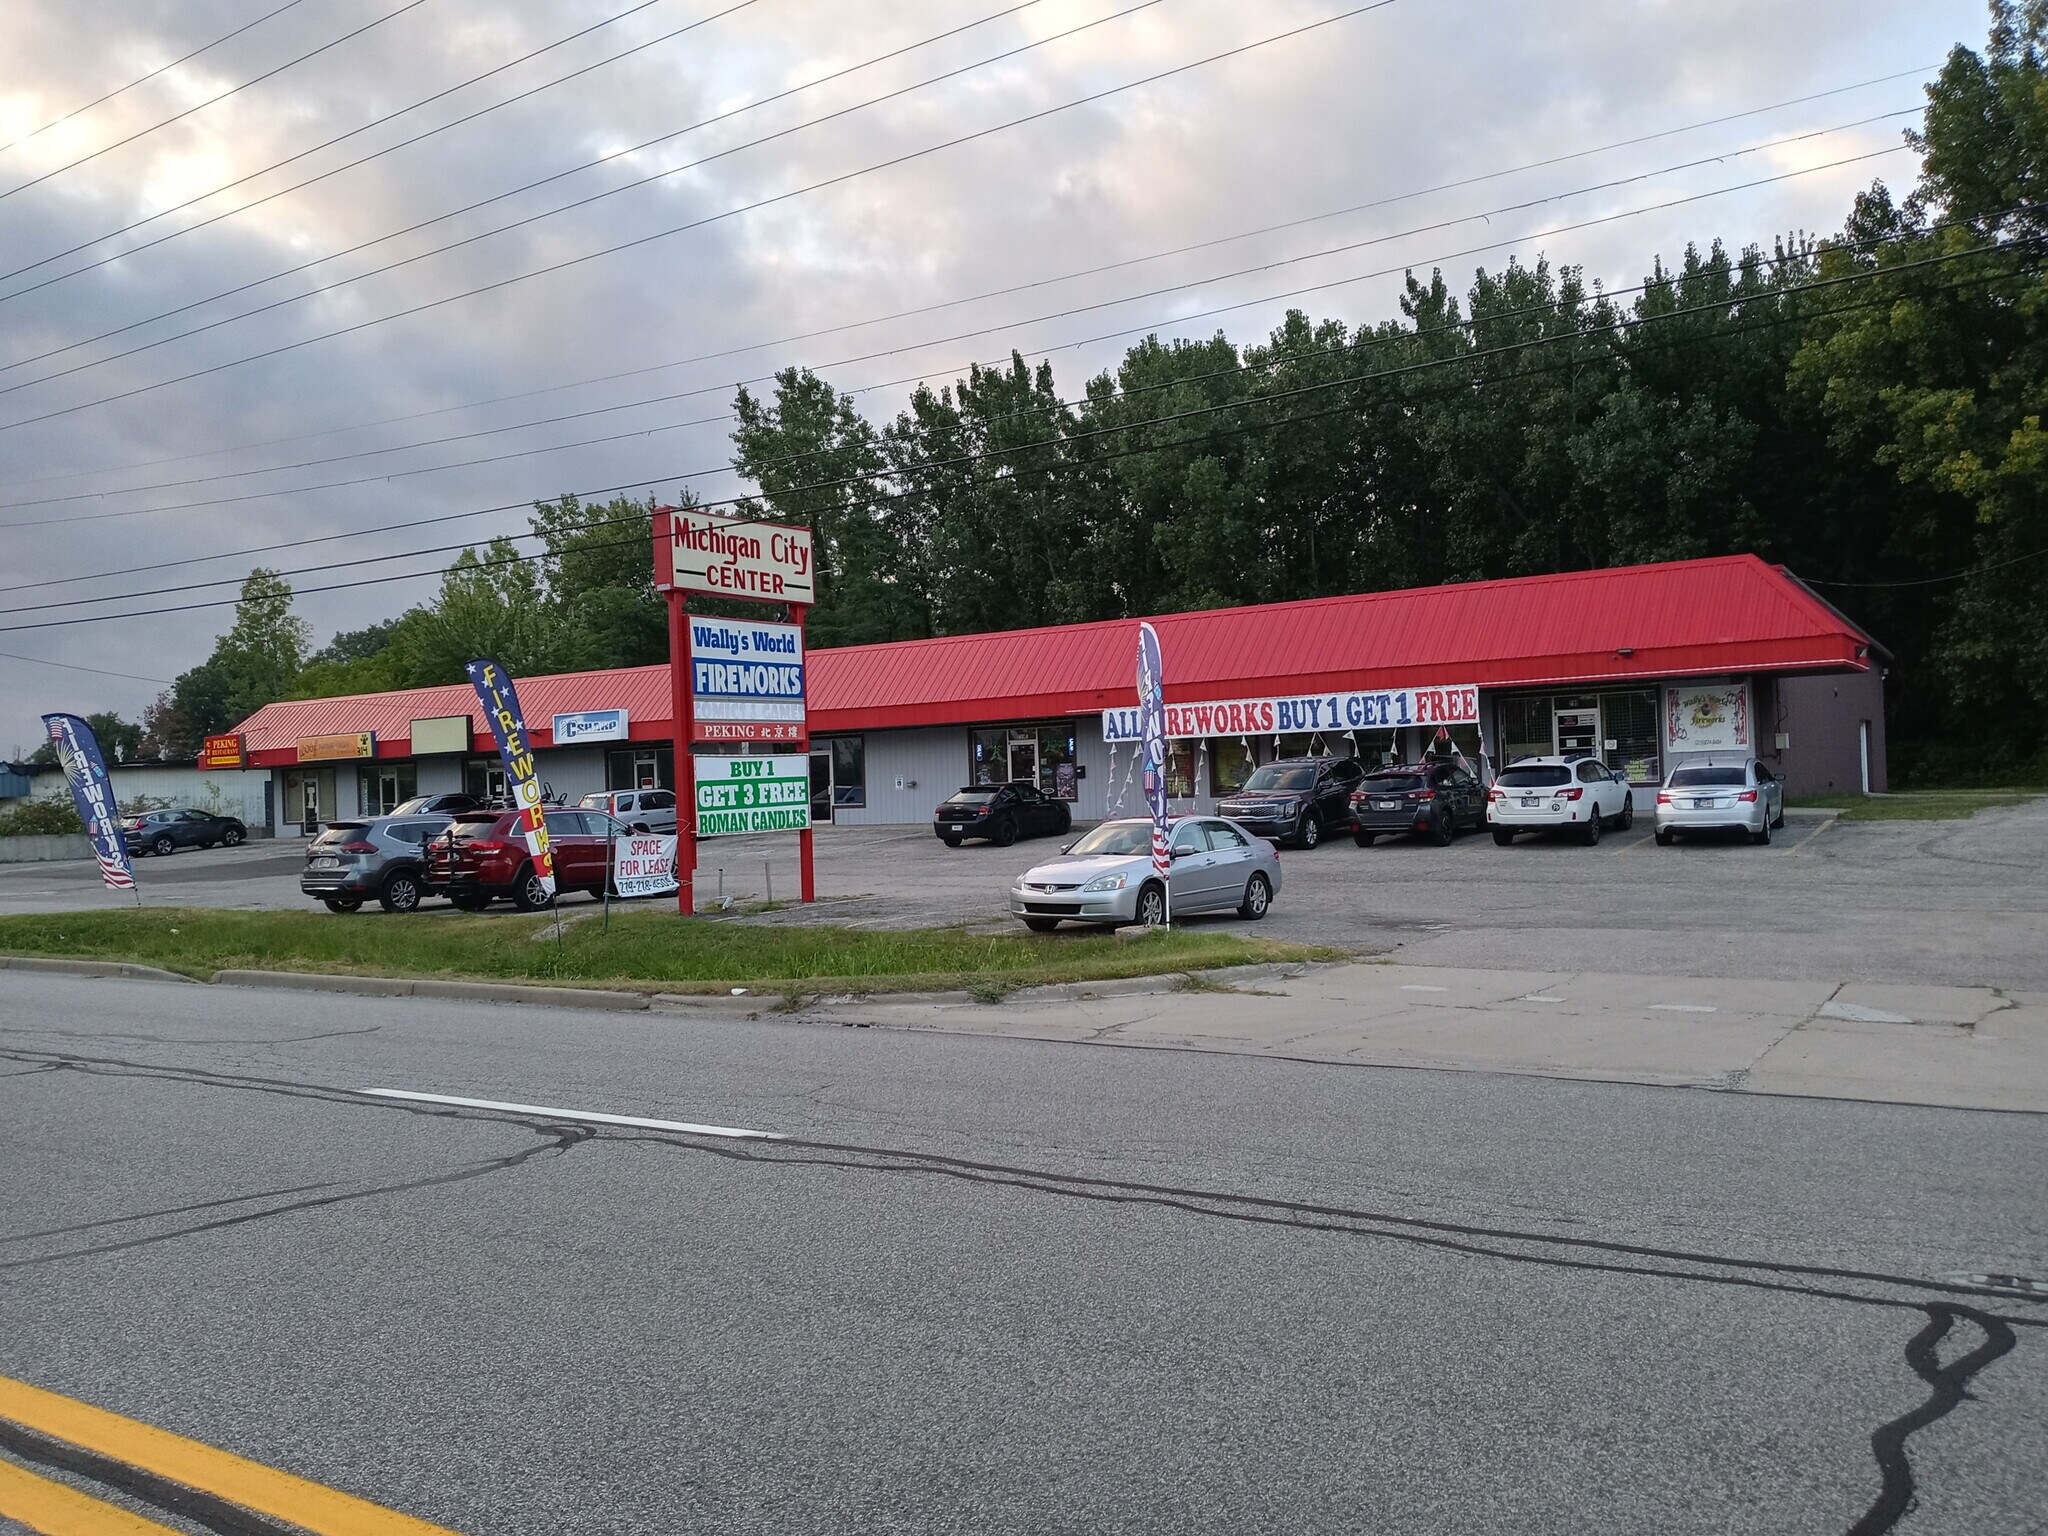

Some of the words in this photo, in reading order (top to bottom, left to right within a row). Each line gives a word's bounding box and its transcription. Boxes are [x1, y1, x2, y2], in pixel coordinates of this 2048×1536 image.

[674, 516, 761, 565] Michigan
[771, 533, 809, 575] City
[706, 565, 784, 594] CENTER
[693, 626, 749, 655] Wally's
[752, 631, 796, 653] World
[695, 662, 802, 695] FIREWORKS
[1105, 711, 1142, 739] ALL
[1163, 702, 1274, 736] REWORKS
[1277, 699, 1322, 729] BUY
[1326, 697, 1342, 728] 1
[1346, 694, 1390, 726] GET
[1395, 692, 1412, 724] 1
[1415, 689, 1478, 722] FREE
[213, 739, 237, 749] PEKING
[705, 725, 754, 738] PEKING
[730, 761, 763, 777] BUY
[766, 761, 775, 776] 1
[699, 785, 739, 807] GET
[743, 784, 755, 805] 3
[758, 781, 807, 804] FREE
[699, 812, 749, 834] ROMAN
[751, 809, 807, 830] CANDLES
[630, 840, 662, 856] SPACE
[620, 860, 640, 876] FOR
[643, 858, 670, 875] LEASE
